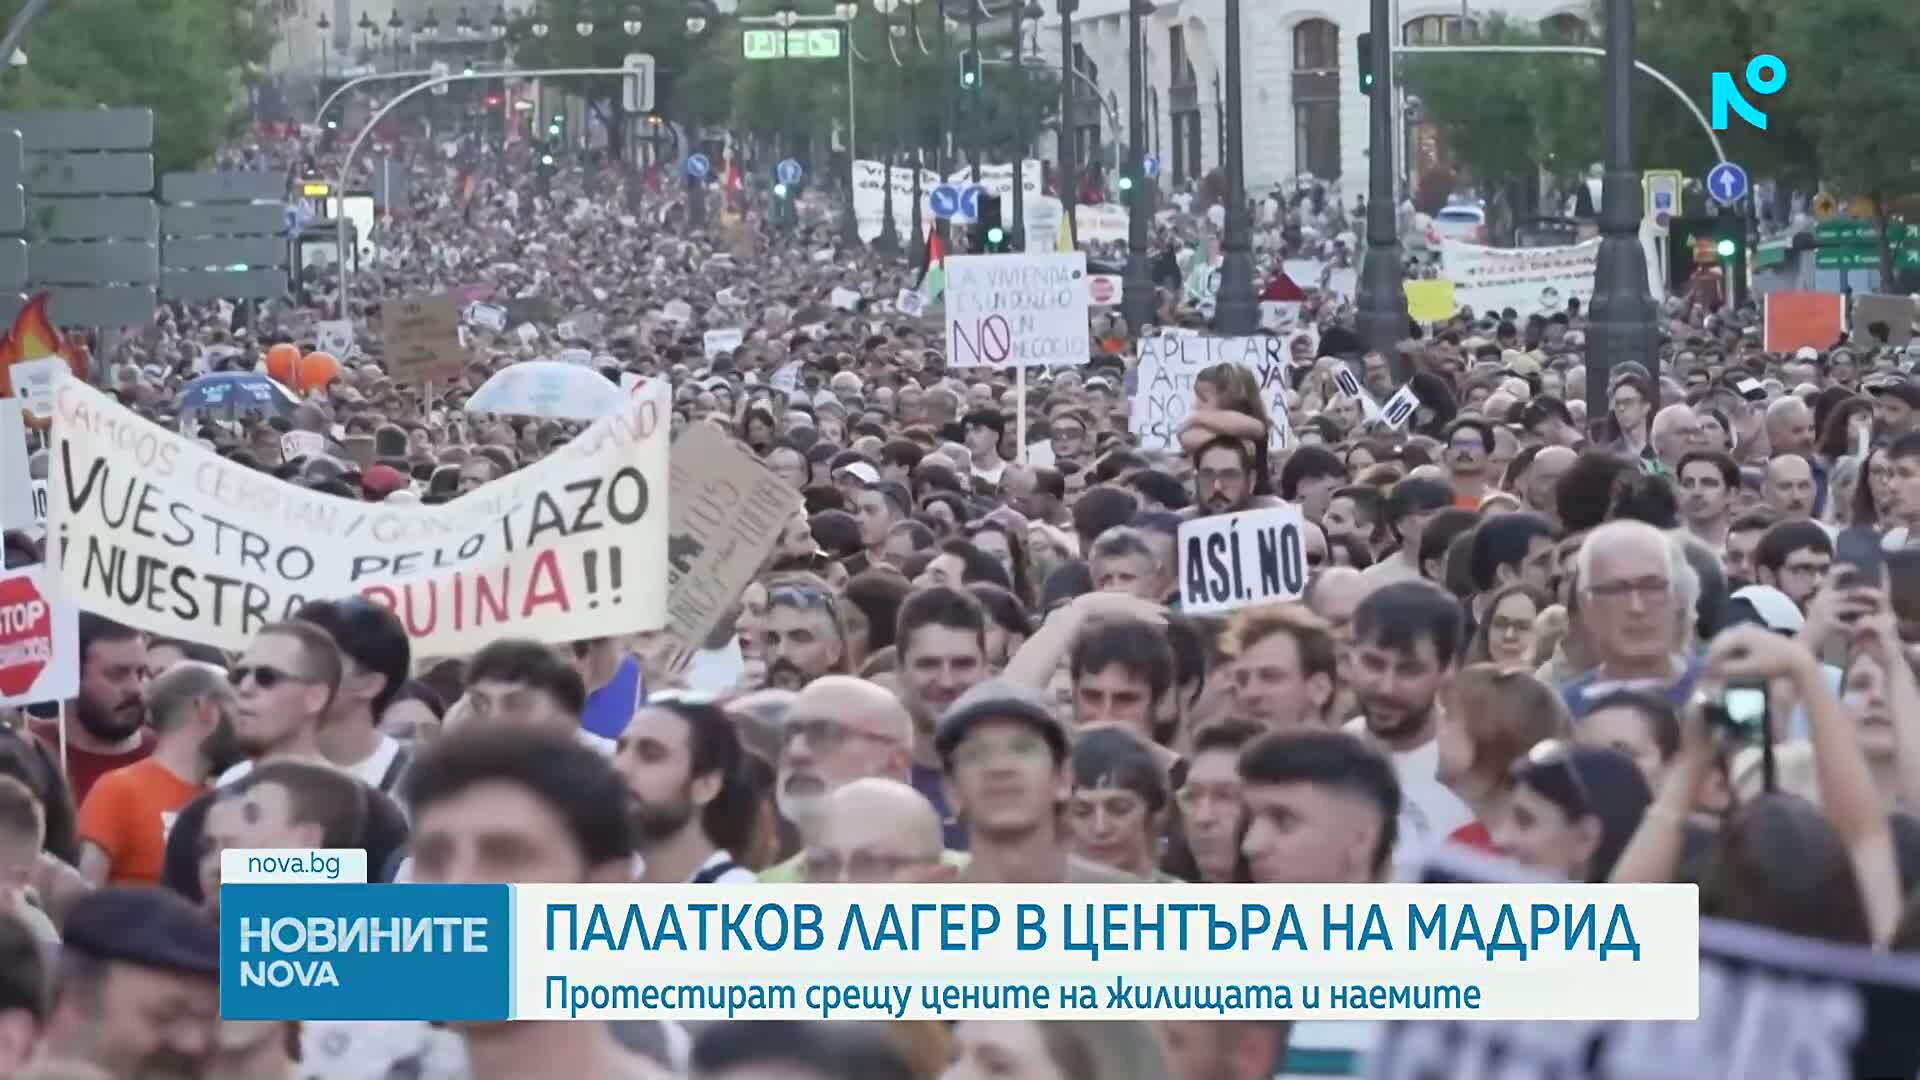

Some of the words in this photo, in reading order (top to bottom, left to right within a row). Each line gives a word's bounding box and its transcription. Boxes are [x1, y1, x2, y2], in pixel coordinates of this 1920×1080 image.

[953, 314, 1011, 364] NO
[61, 439, 315, 581] VUESTRO
[1256, 523, 1303, 597] NO
[0, 600, 45, 635] TOP
